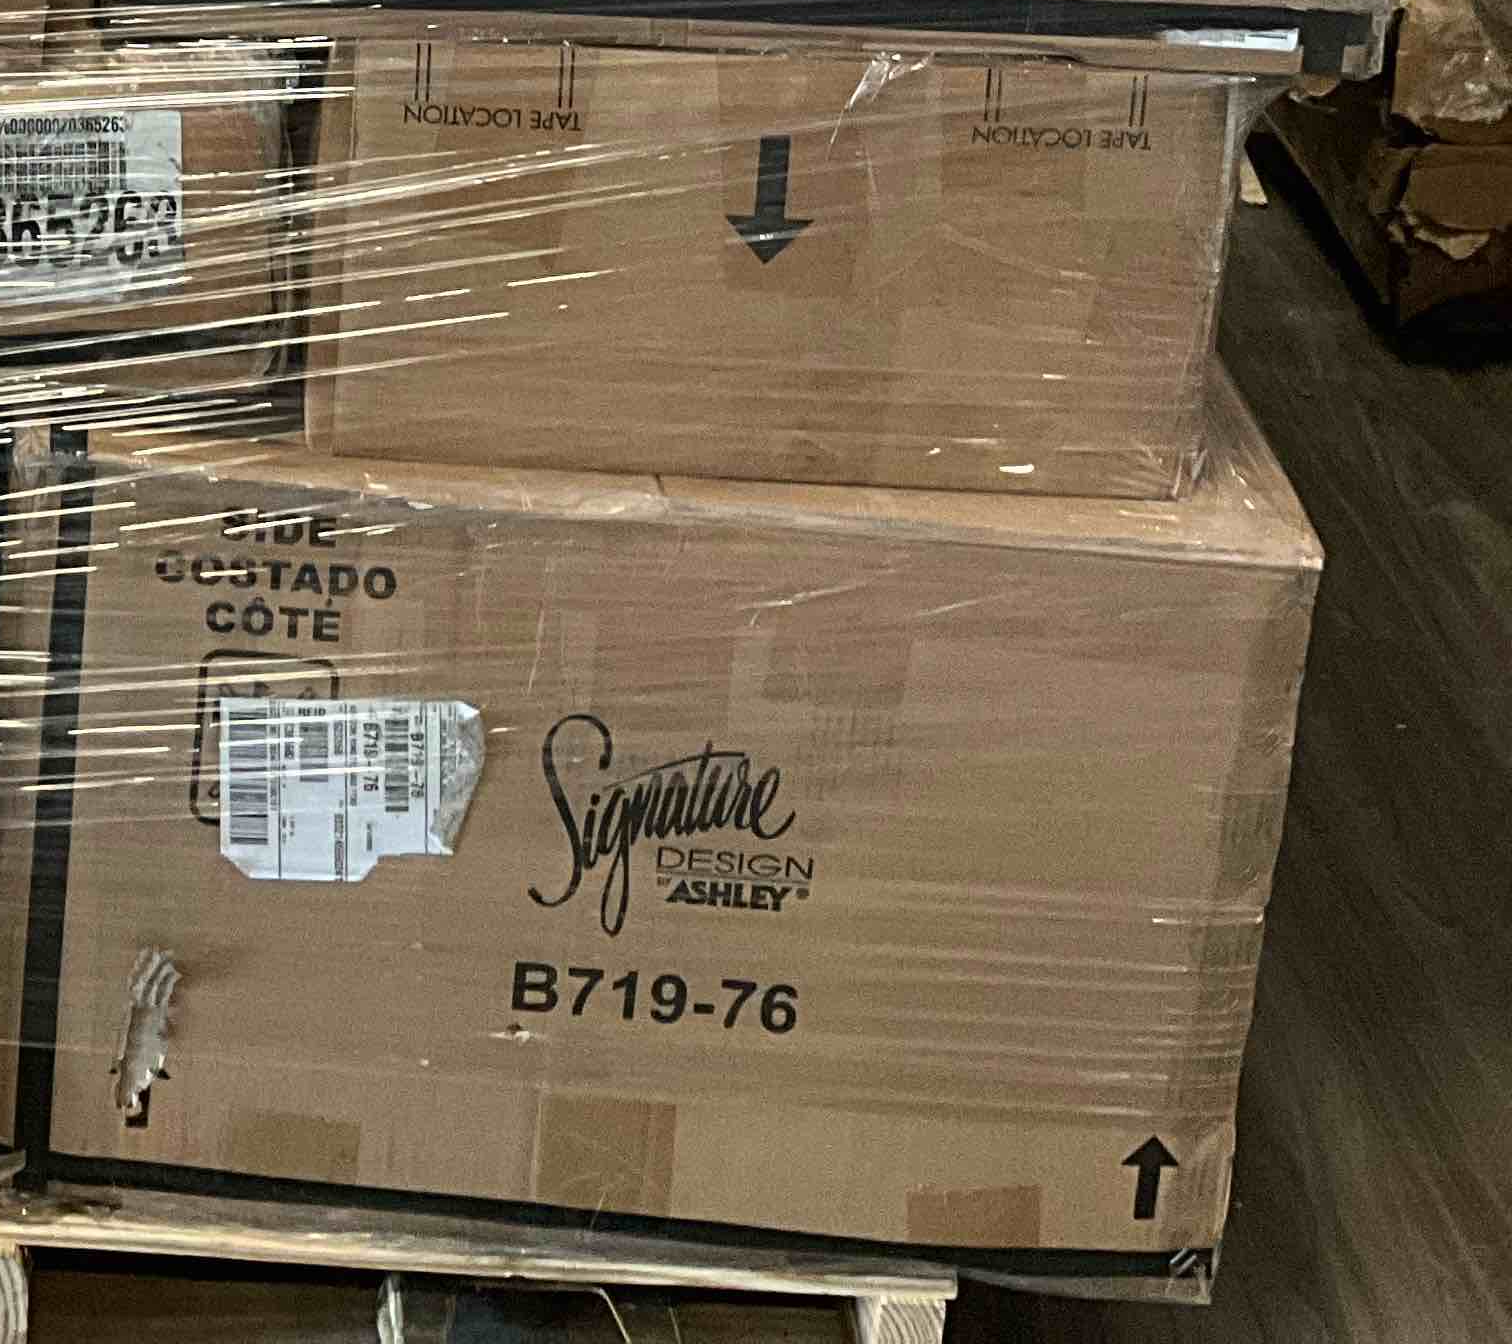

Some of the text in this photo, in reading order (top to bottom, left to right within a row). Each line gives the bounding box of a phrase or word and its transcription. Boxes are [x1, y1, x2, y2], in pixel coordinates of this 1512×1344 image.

[402, 101, 583, 133] TAPE LOCATION
[970, 123, 1152, 152] TAPE LOCATION
[219, 507, 338, 550] SIDE
[153, 550, 398, 600] COSTADO
[205, 598, 342, 644] CÔTÉ
[527, 714, 797, 938] Signature
[656, 846, 816, 881] DESIGN
[665, 878, 792, 913] ASHLEY
[510, 960, 800, 1035] B719-76
